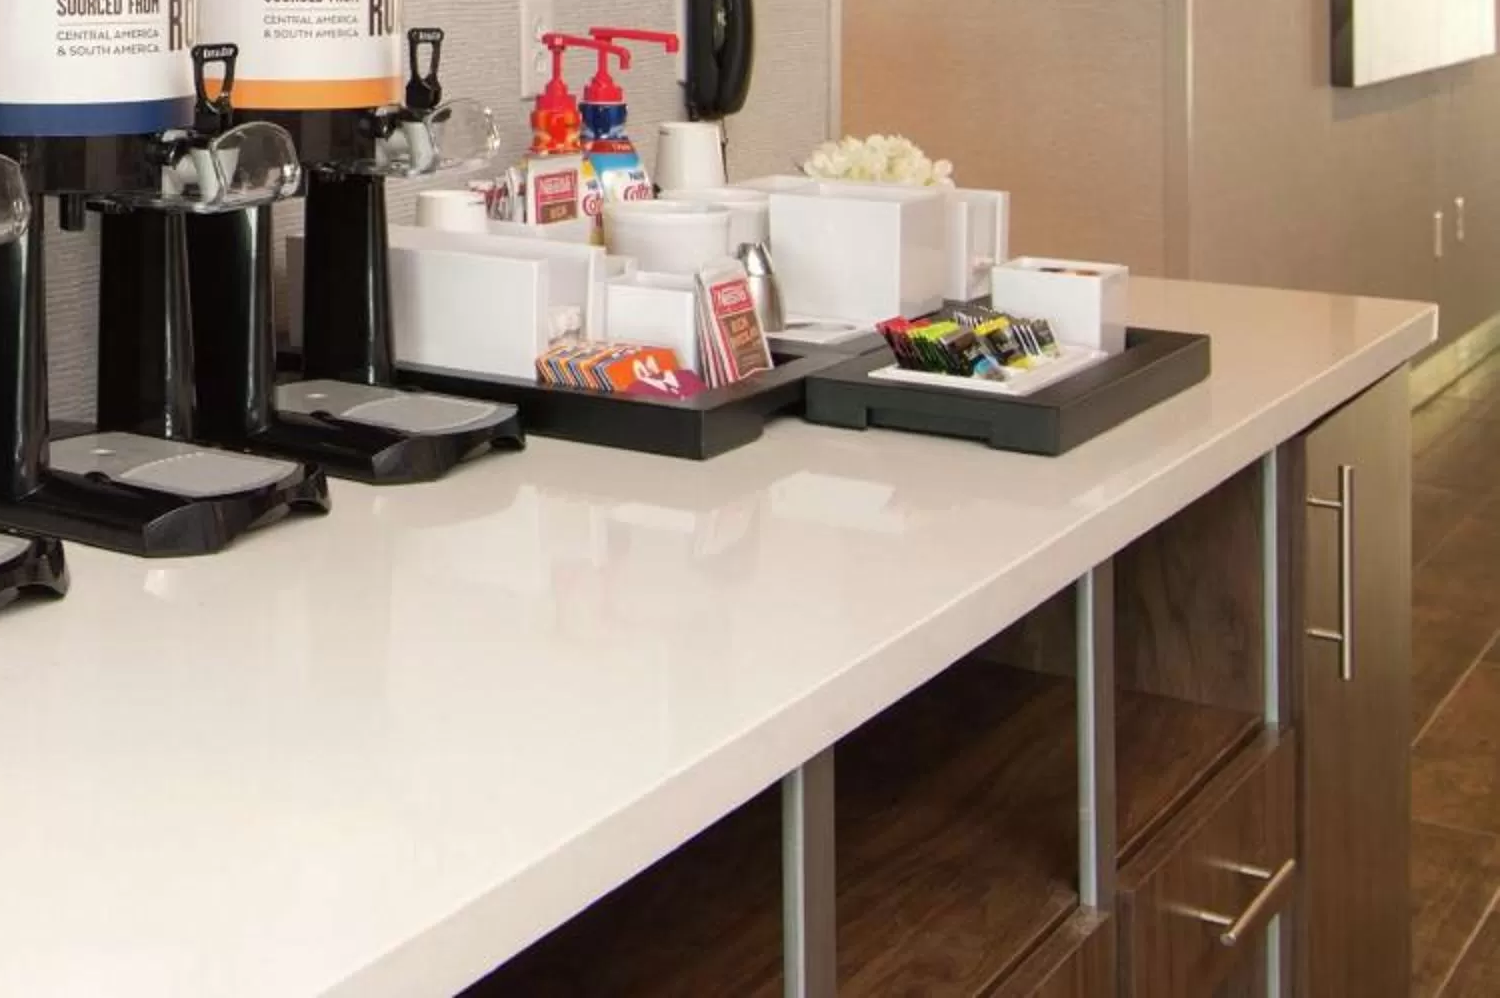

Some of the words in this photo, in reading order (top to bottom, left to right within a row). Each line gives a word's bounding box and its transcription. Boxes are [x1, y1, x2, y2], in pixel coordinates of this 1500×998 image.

[263, 15, 313, 25] CENTRAL
[315, 14, 358, 25] AMERICA
[57, 29, 113, 41] CENTRAL
[114, 28, 160, 39] AMERICA
[274, 28, 312, 39] SOUTH
[315, 28, 360, 39] AMERICA
[69, 45, 111, 56] SOUTH
[113, 43, 160, 55] AMERICA
